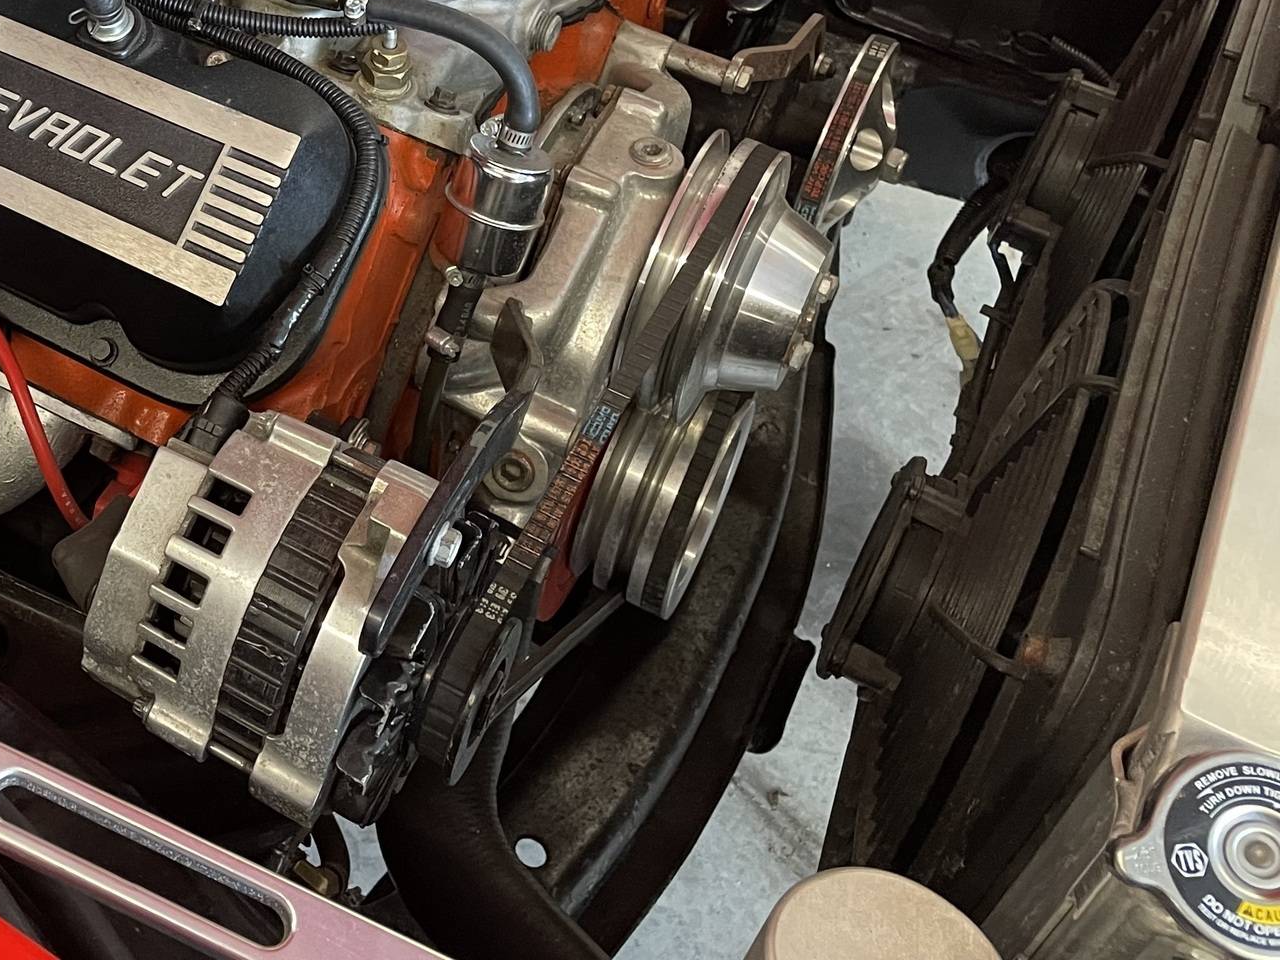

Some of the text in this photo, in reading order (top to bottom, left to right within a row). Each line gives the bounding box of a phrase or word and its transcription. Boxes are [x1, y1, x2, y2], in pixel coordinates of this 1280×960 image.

[1194, 765, 1280, 790] REMOVE SLOWL
[1198, 785, 1280, 814] TURN DOWN TIG
[1177, 848, 1205, 872] TVS
[1202, 894, 1224, 915] DO
[1222, 909, 1253, 930] NOT
[1253, 922, 1280, 938] OPE
